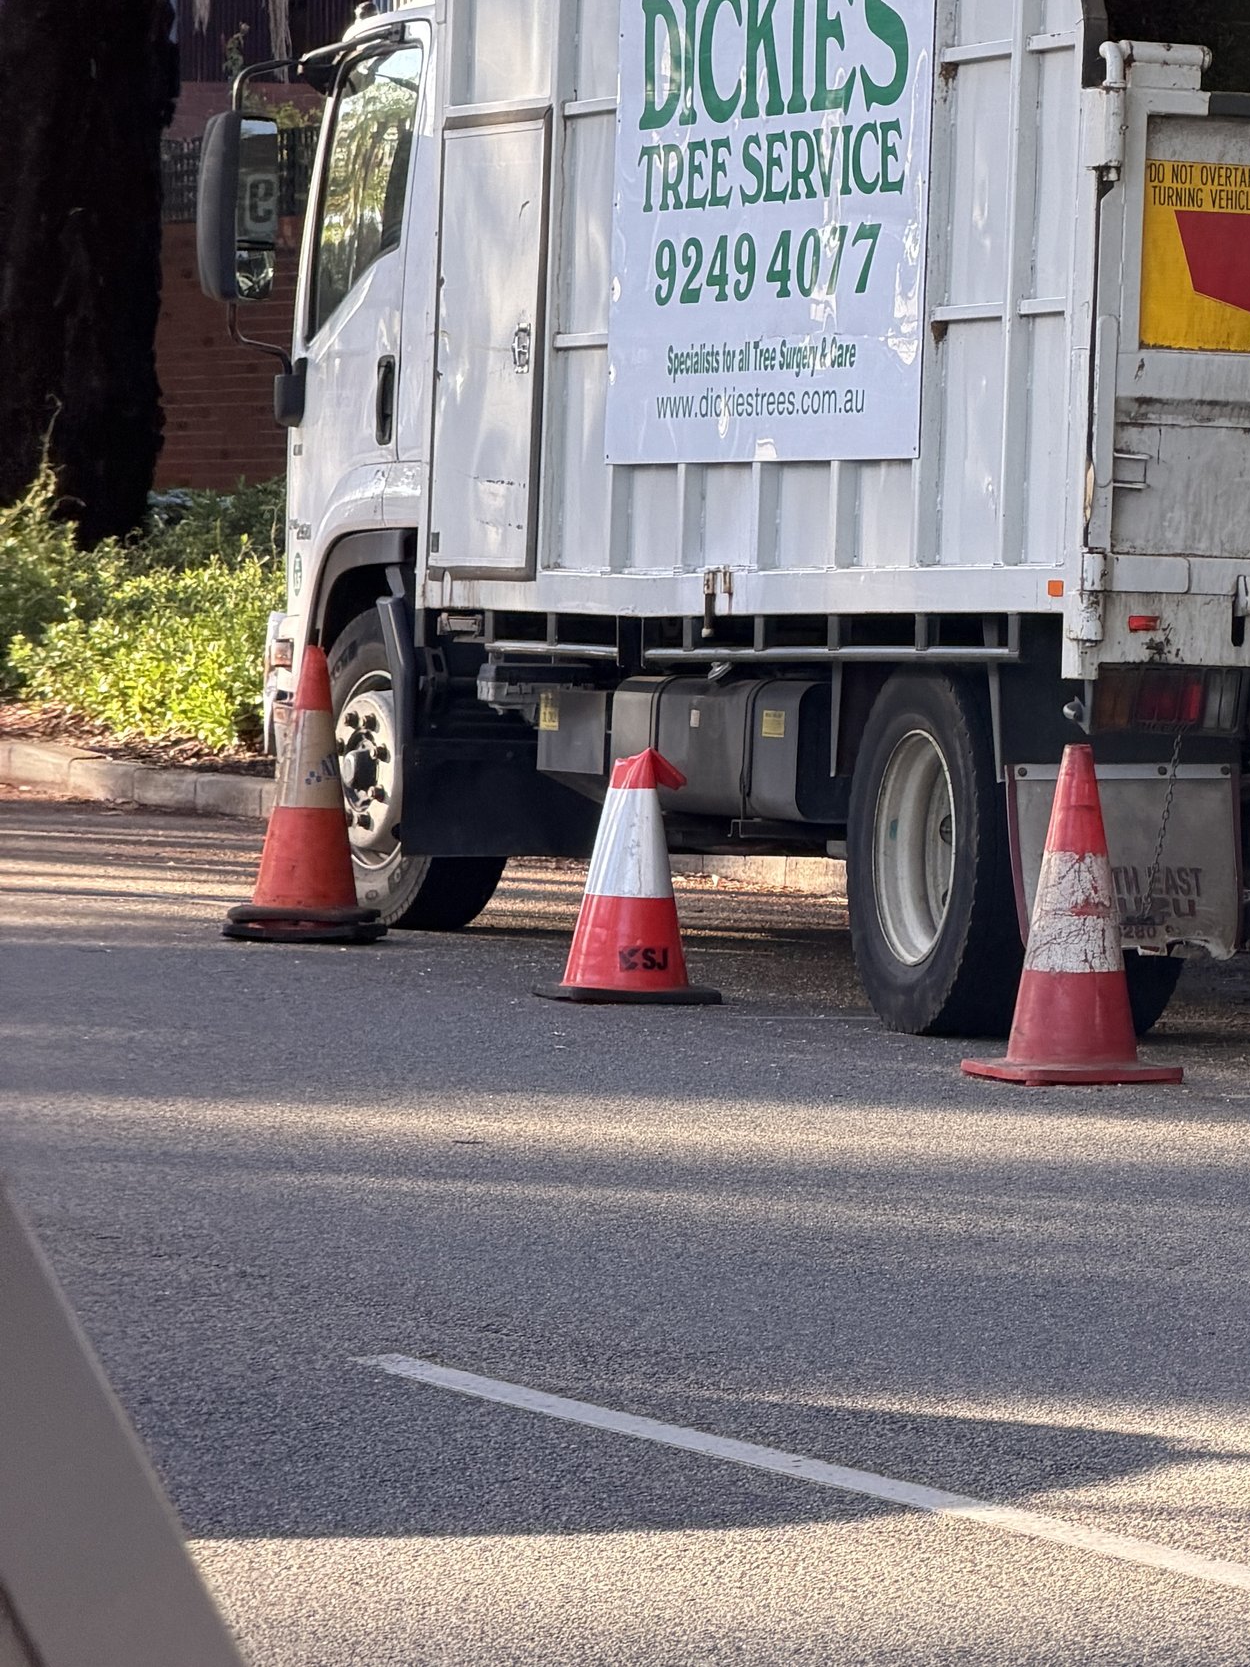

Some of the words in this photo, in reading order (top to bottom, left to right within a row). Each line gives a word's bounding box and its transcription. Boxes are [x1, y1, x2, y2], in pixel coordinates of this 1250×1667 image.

[637, 135, 733, 213] TREE
[741, 118, 905, 207] SERVICE
[1149, 162, 1166, 184] DO
[1171, 164, 1195, 185] NOT
[1151, 185, 1204, 209] TURNING
[654, 231, 757, 307] 9249
[766, 222, 882, 301] 4077
[667, 343, 720, 383] Specialists
[722, 342, 736, 373] for
[738, 341, 751, 372] all
[753, 340, 777, 372] Tree
[778, 339, 818, 378] Surgery
[819, 337, 828, 368] &
[830, 336, 856, 369] Care
[656, 387, 866, 420] www.dickiestrees.com.au
[1146, 866, 1202, 897] EAST
